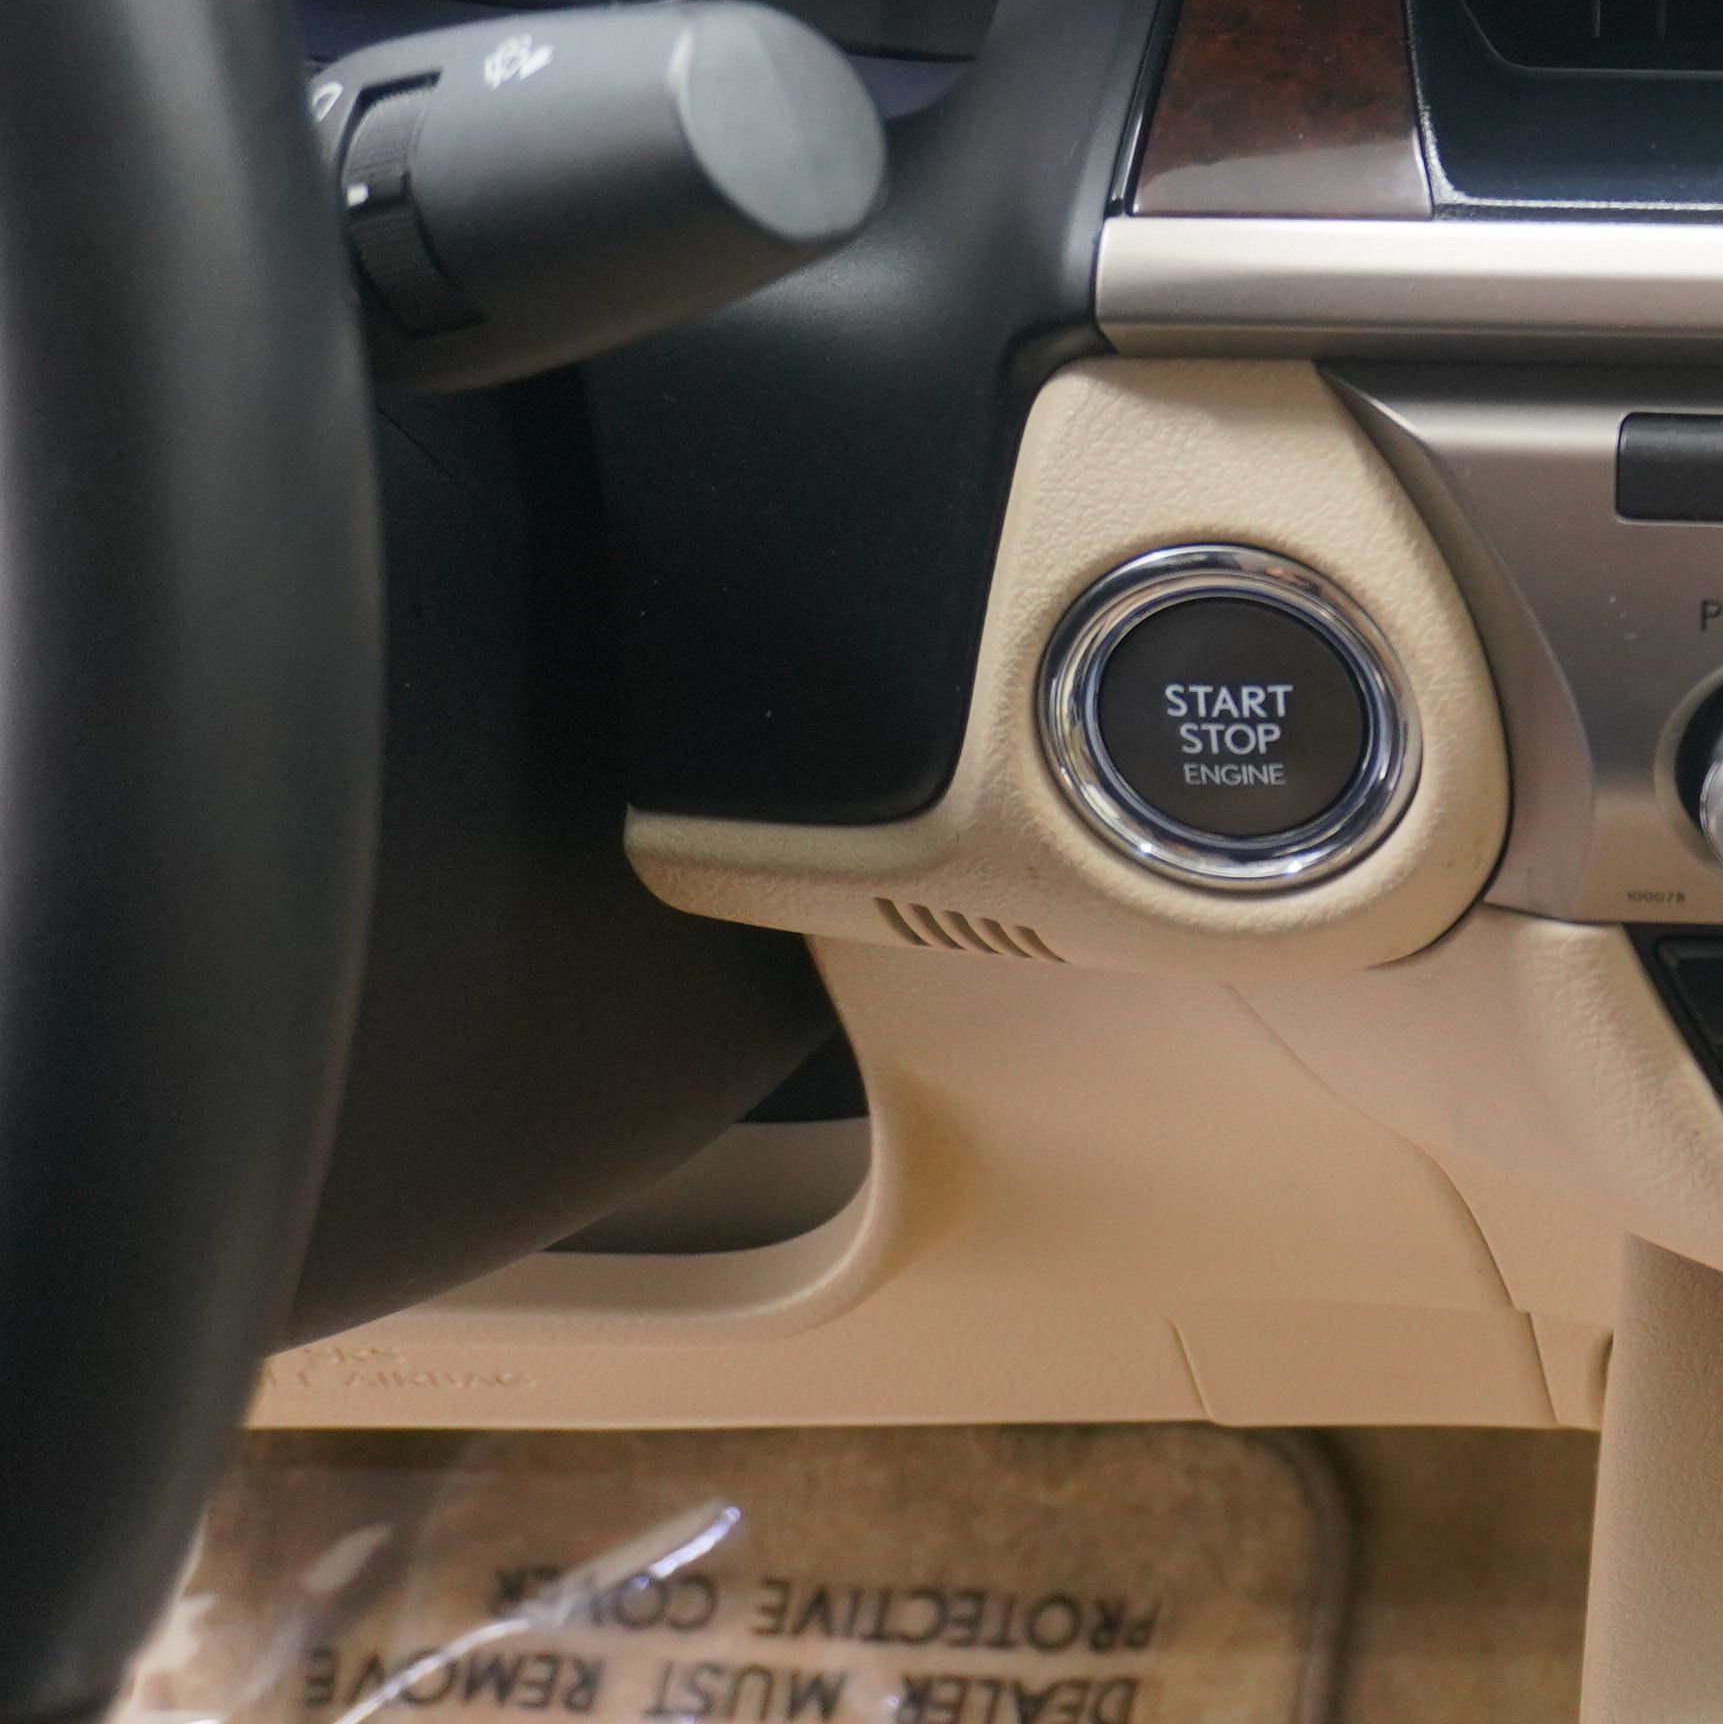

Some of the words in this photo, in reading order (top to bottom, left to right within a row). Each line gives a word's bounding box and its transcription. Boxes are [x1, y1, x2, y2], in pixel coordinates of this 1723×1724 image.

[1163, 683, 1293, 719] START
[1179, 721, 1282, 756] STOP
[1184, 761, 1287, 788] ENGINE
[753, 1576, 1162, 1654] PROTECTIVE
[302, 1646, 607, 1717] REMOVE
[643, 1660, 850, 1722] MUST
[899, 1672, 1142, 1724] DEALER
